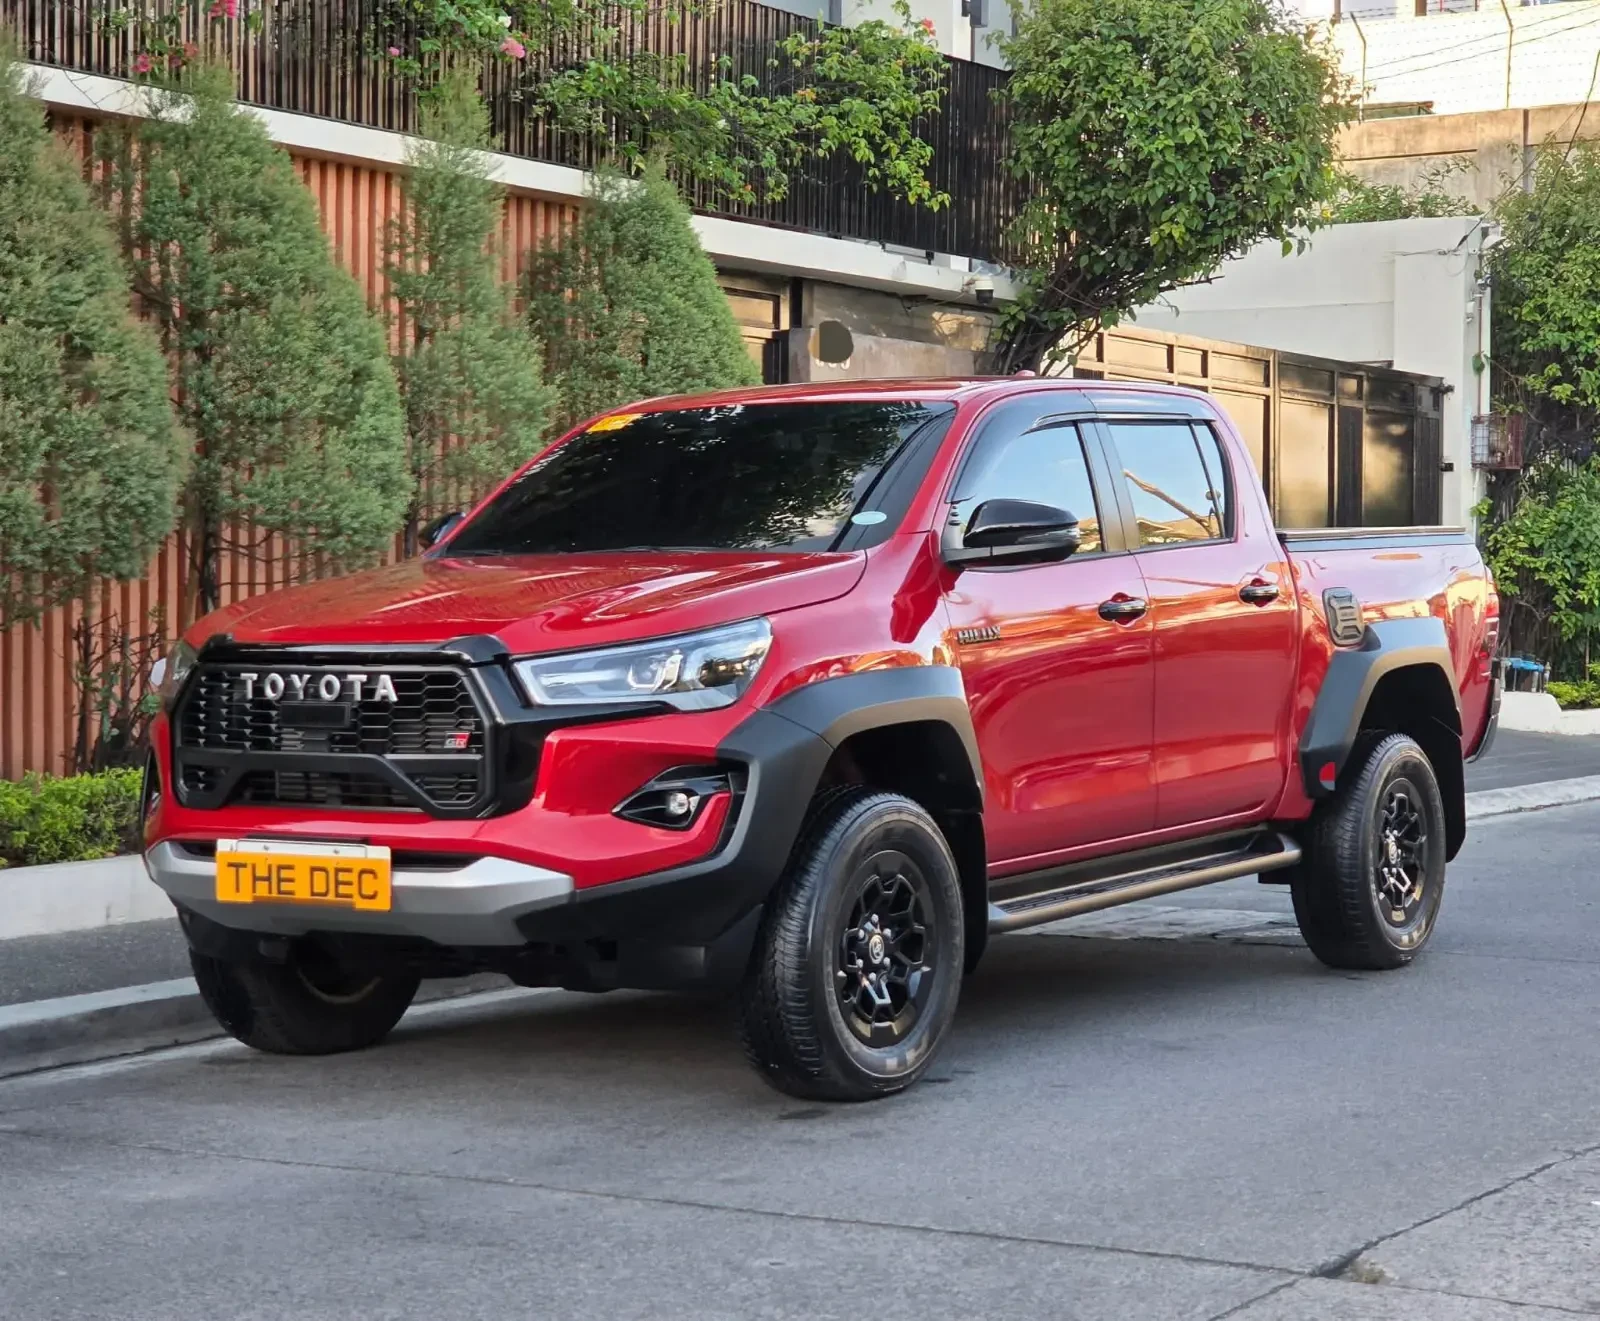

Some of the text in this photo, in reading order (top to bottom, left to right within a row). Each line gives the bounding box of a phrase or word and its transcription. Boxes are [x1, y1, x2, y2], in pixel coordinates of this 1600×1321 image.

[240, 672, 398, 702] TOYOTA
[444, 736, 468, 749] GR
[227, 862, 379, 900] THE DEC
